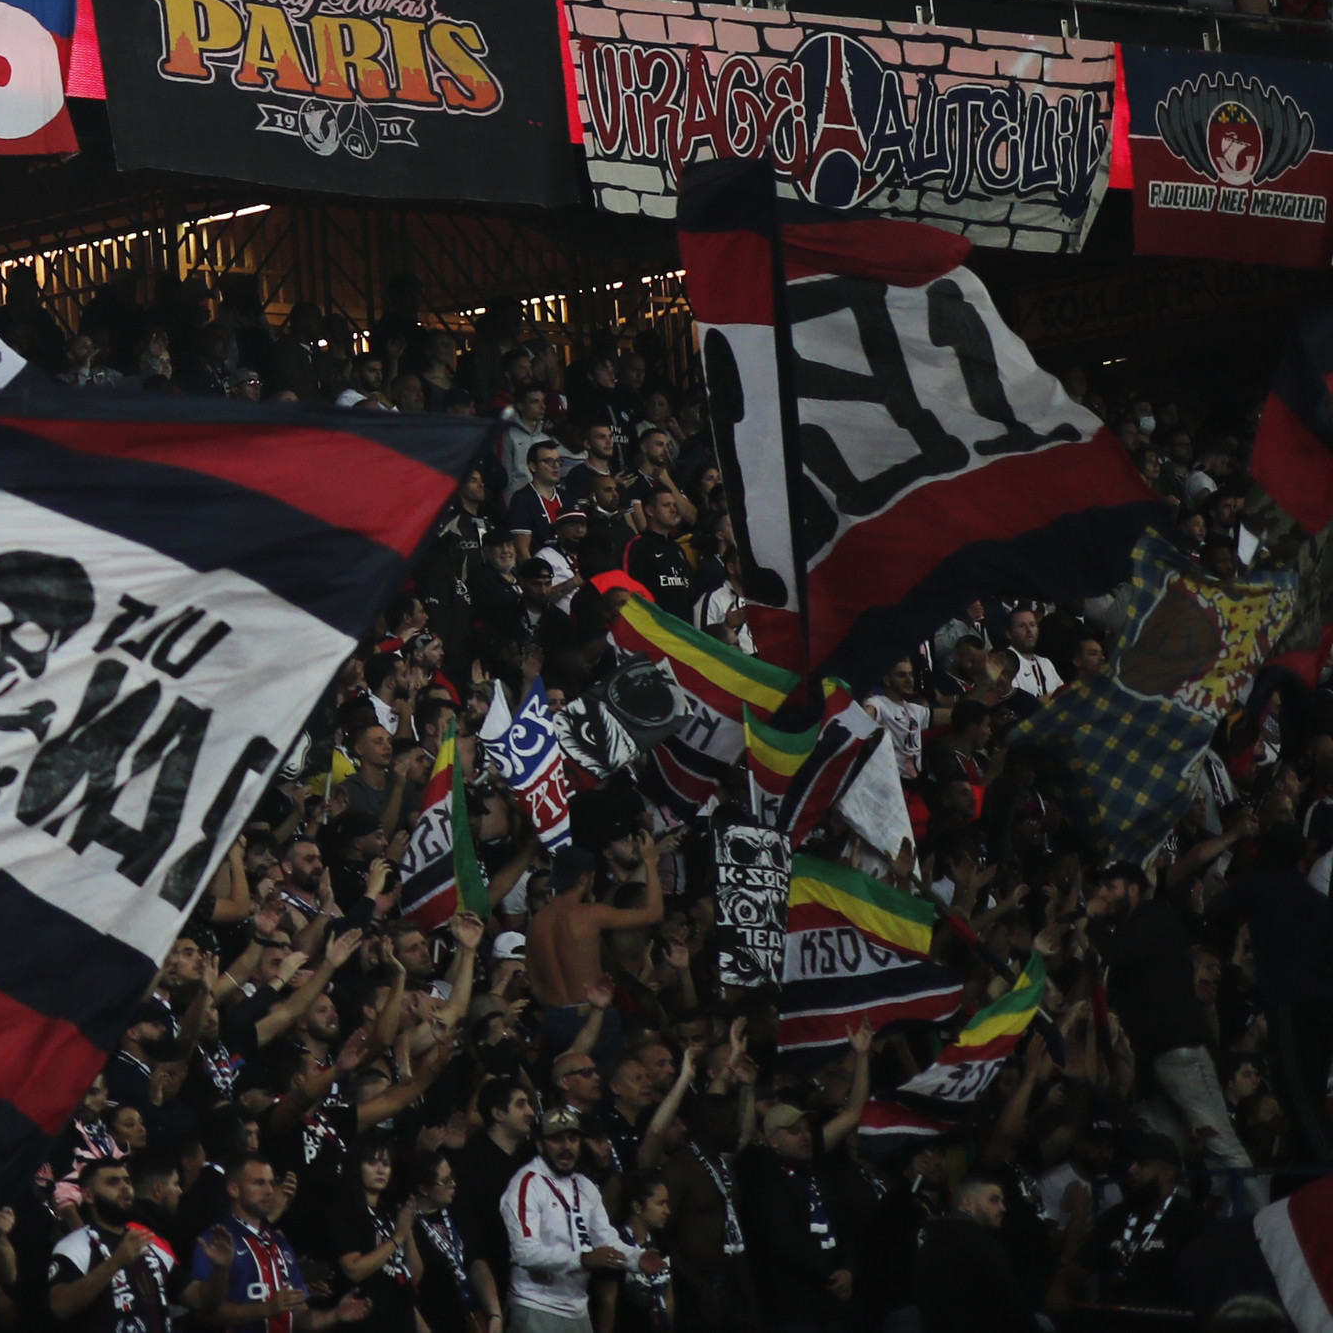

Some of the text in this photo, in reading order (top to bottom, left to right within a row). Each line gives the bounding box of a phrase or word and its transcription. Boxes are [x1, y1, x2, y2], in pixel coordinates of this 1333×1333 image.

[272, 112, 403, 137] 19 70
[862, 70, 1109, 212] AUTEUIL
[1218, 187, 1249, 215] NEC
[1251, 189, 1327, 224] MERGITUR
